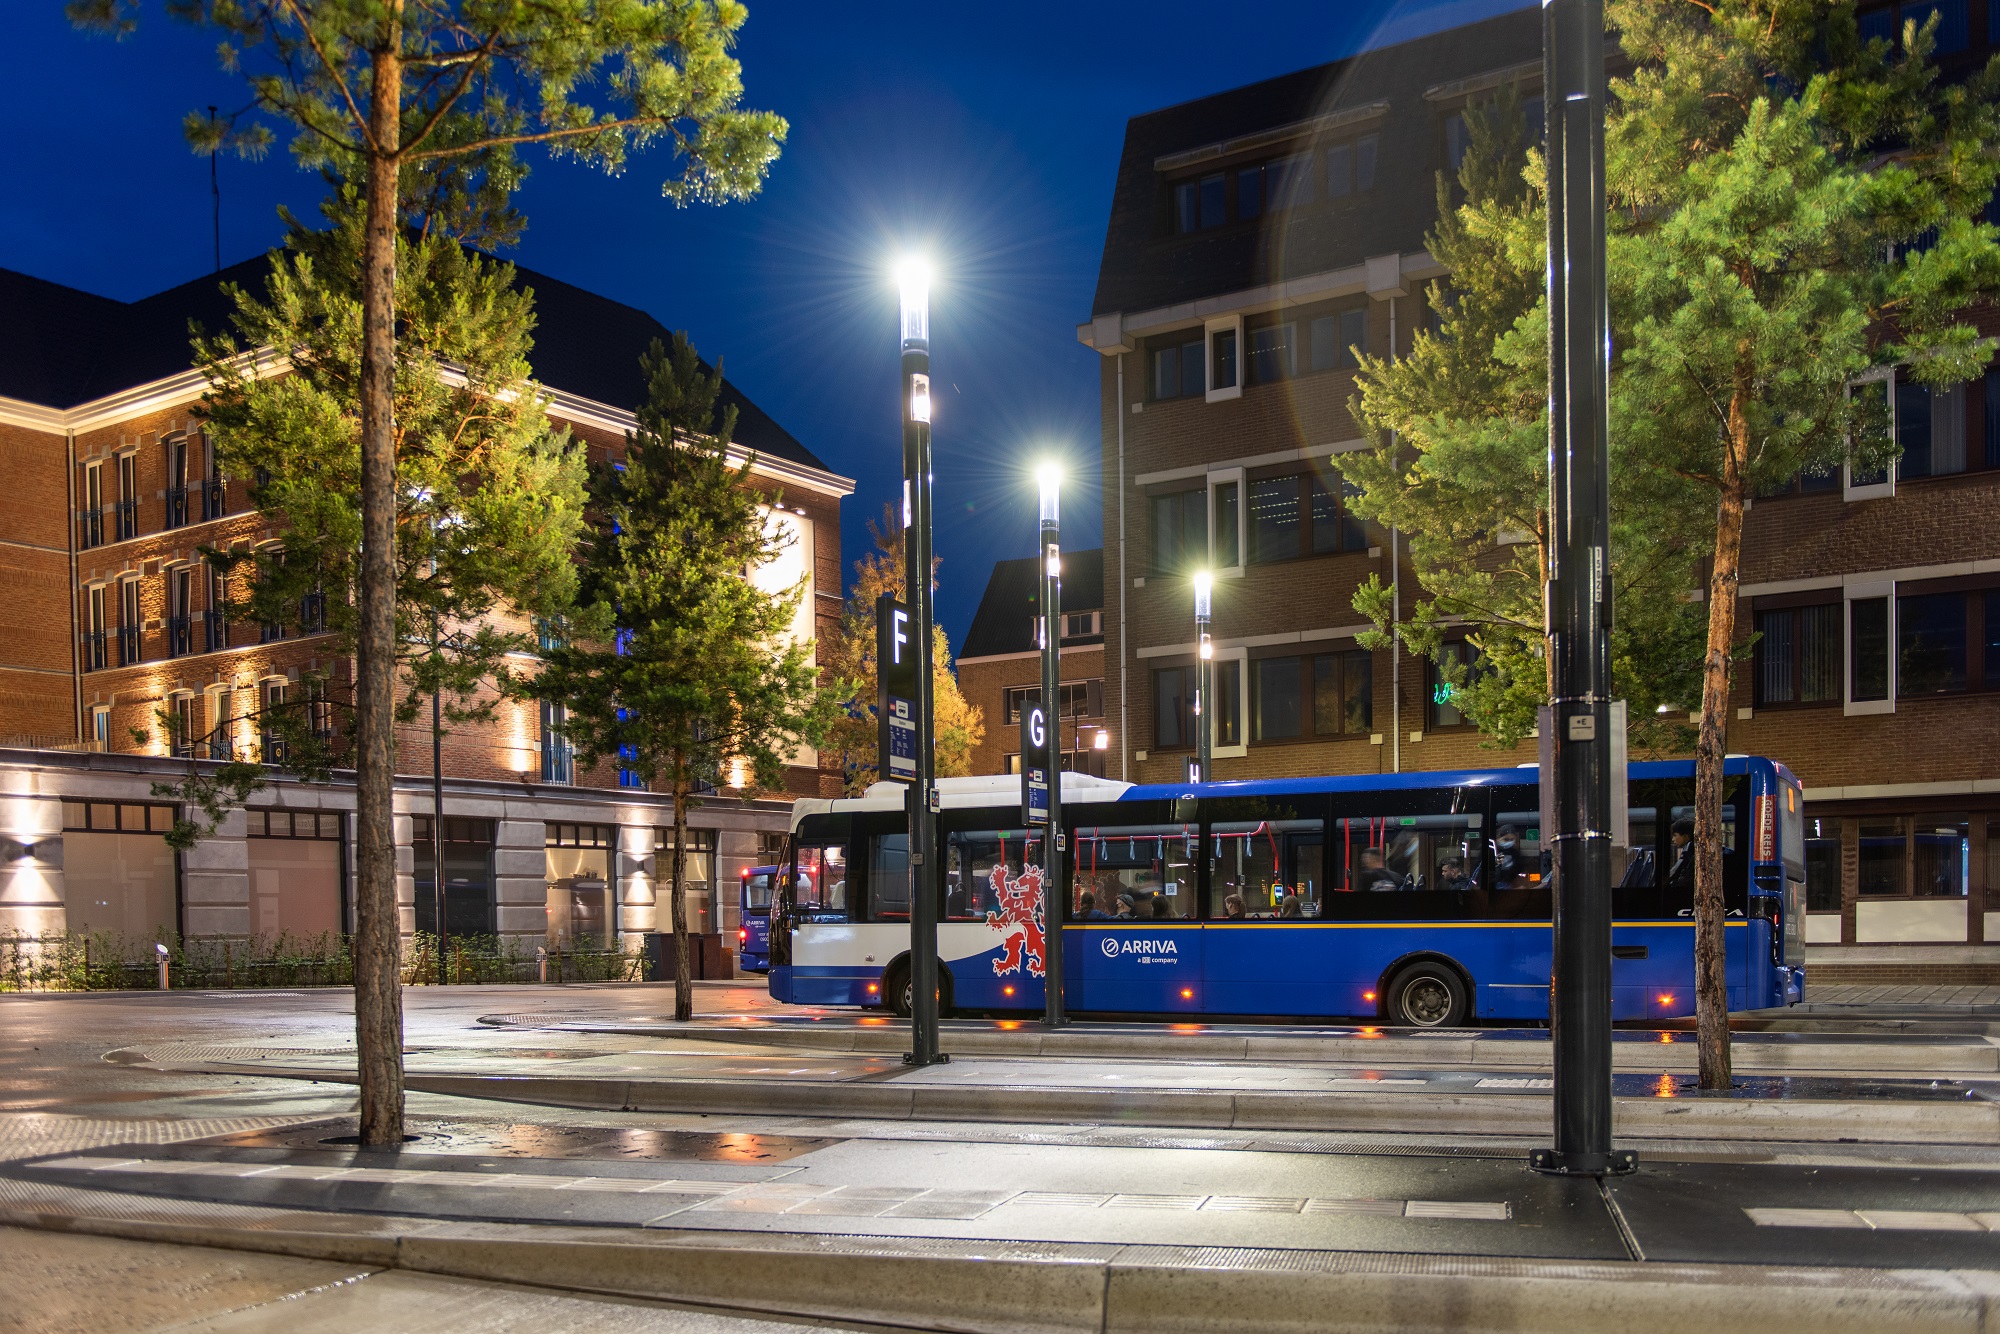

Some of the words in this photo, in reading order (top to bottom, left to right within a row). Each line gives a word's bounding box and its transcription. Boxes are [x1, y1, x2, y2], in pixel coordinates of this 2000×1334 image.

[894, 609, 908, 664] F
[1031, 708, 1043, 747] G
[1189, 763, 1199, 785] H
[1764, 799, 1773, 831] GOEDE
[1763, 833, 1772, 857] REIS
[1121, 940, 1178, 954] ARRIVA
[1151, 957, 1178, 965] company
